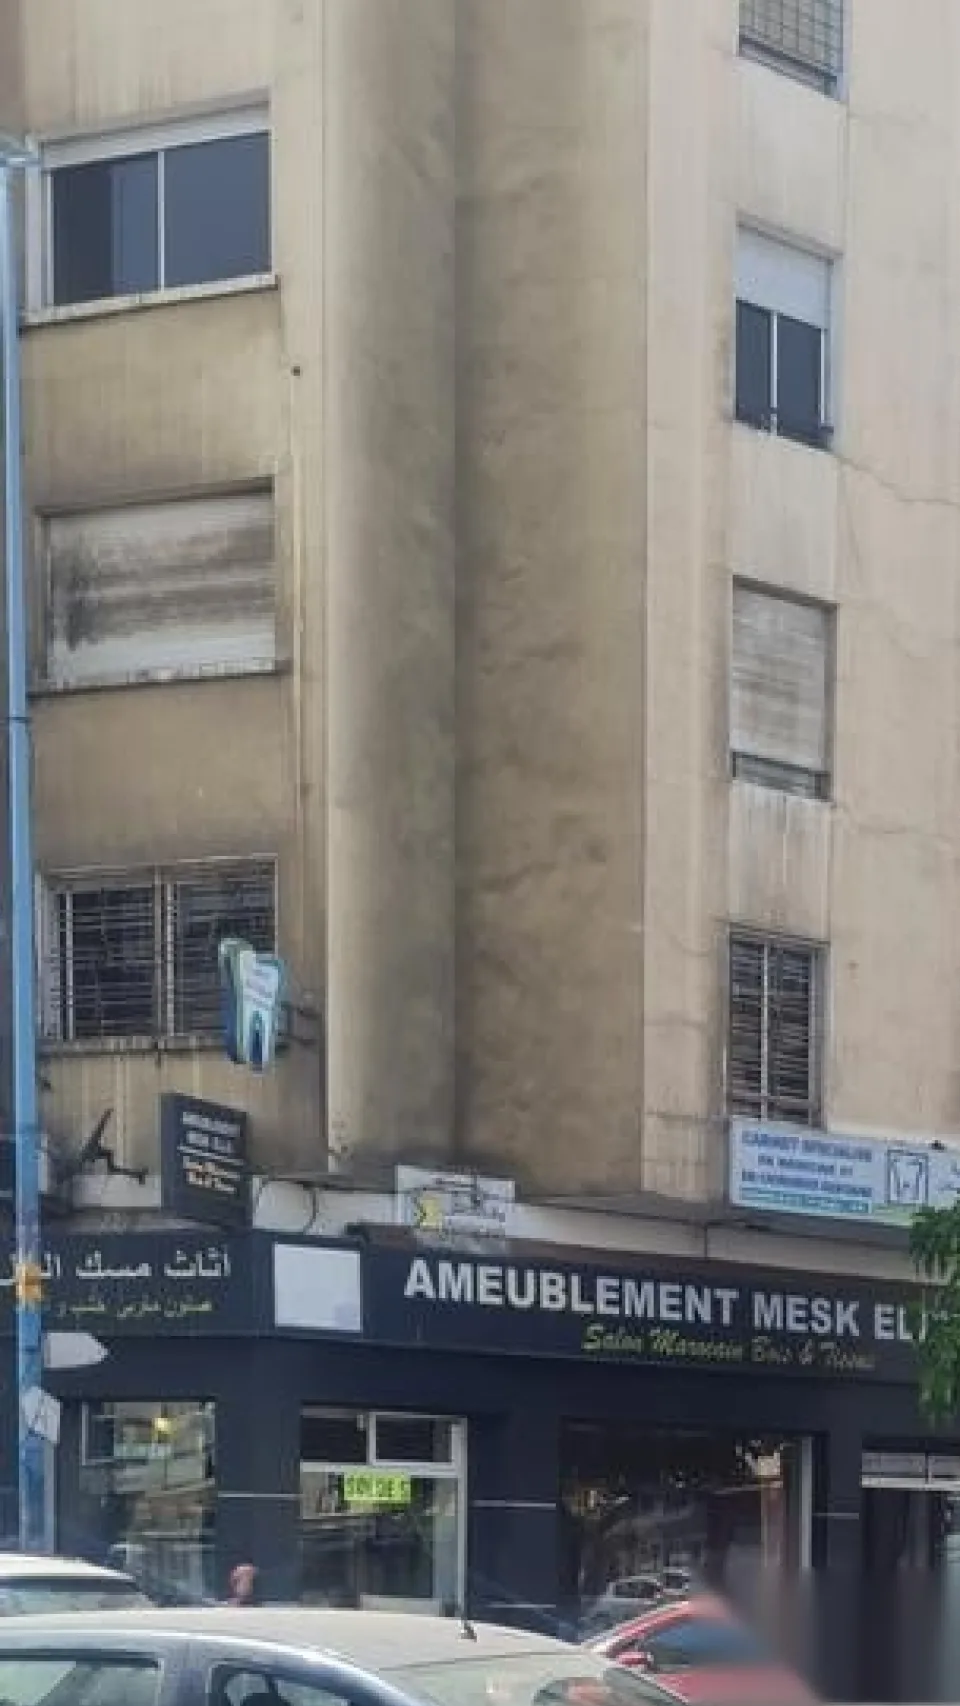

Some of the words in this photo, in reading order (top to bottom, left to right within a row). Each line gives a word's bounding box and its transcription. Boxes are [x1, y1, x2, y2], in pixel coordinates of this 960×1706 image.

[76, 1249, 152, 1279] مسك
[403, 1255, 740, 1328] AMEUBLEMENT
[753, 1291, 862, 1338] MESK
[580, 1321, 643, 1354] Salon
